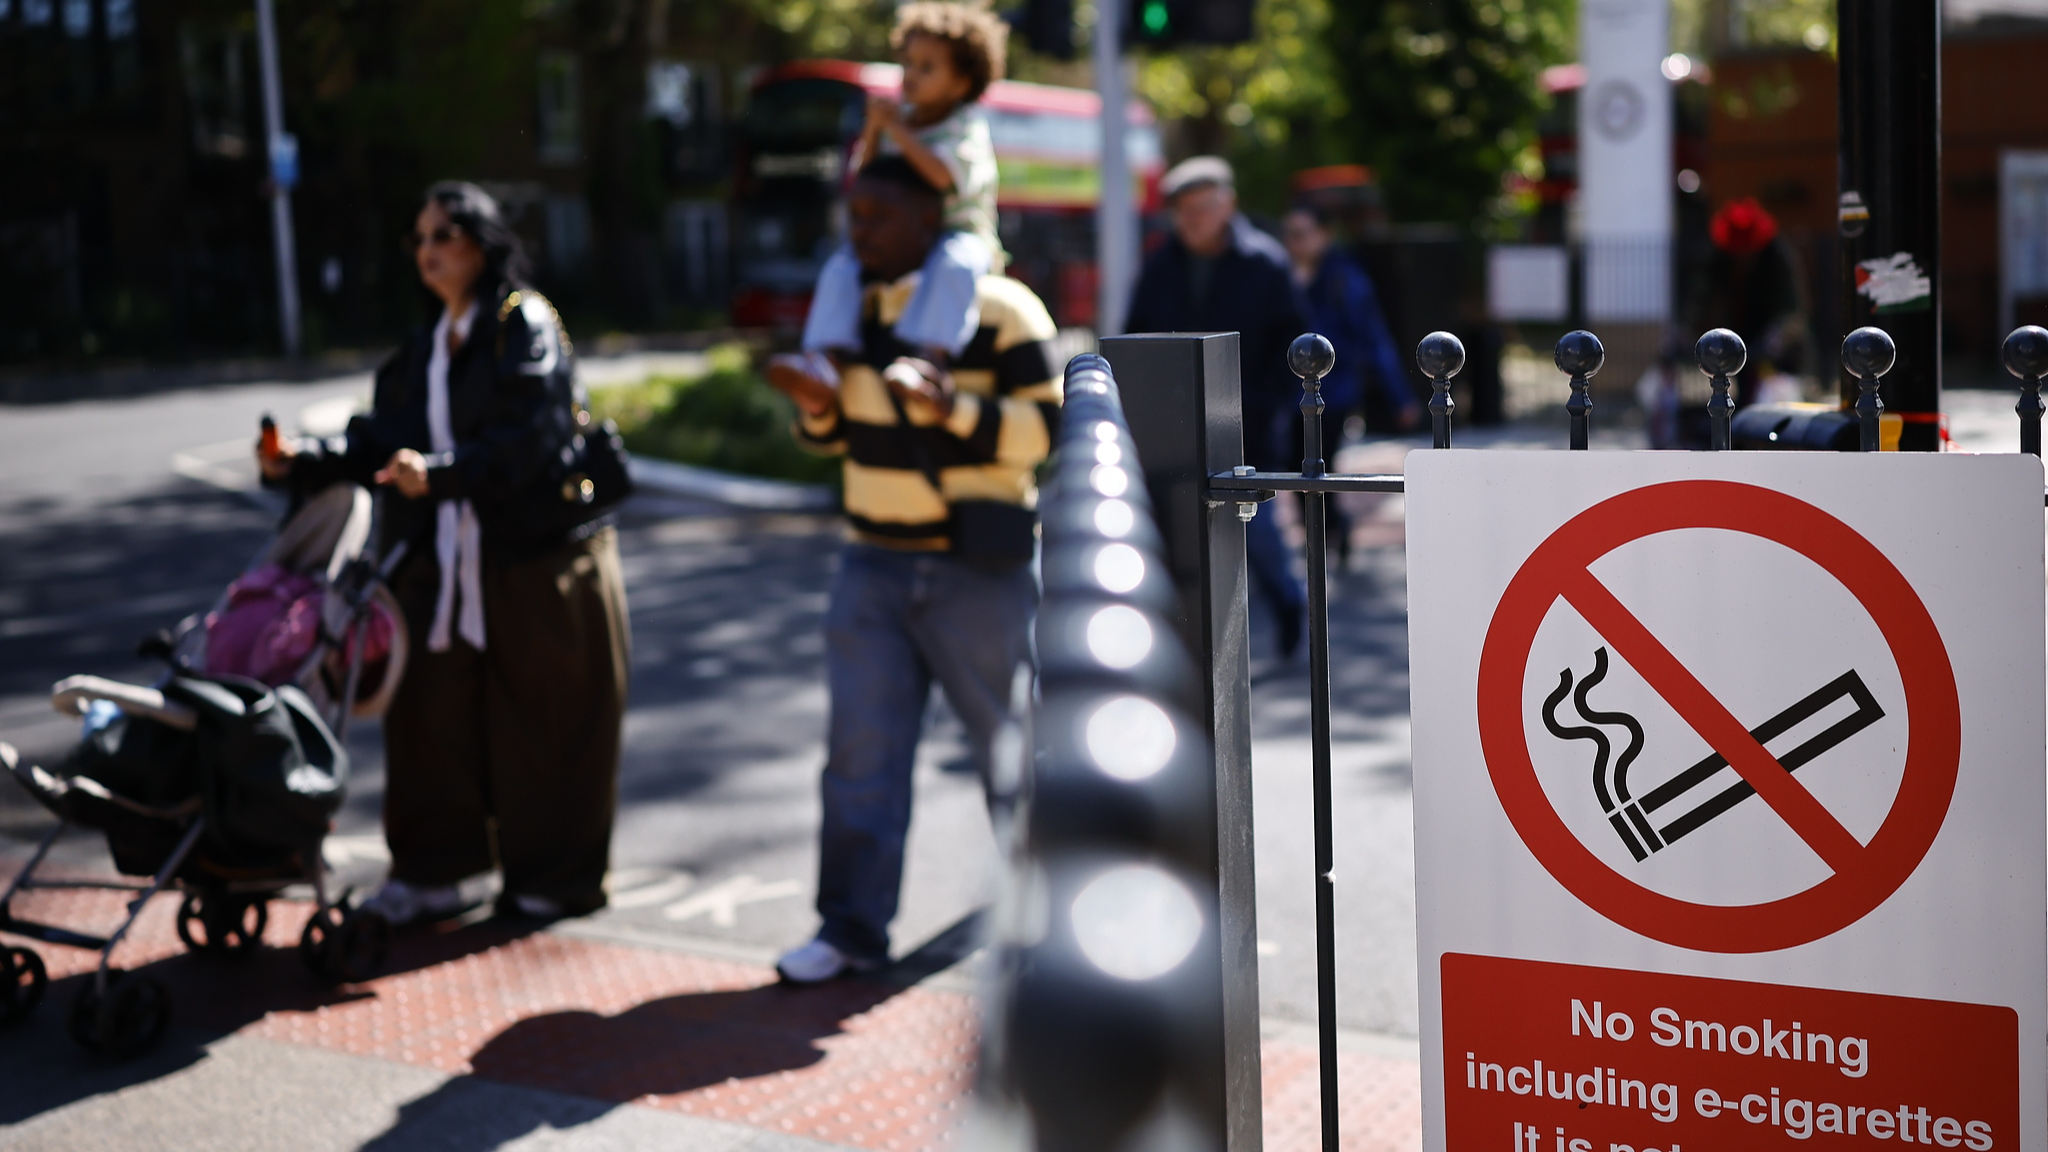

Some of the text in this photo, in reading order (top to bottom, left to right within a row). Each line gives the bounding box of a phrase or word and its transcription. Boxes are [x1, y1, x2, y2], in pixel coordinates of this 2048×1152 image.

[1570, 998, 1869, 1078] No Smoking
[1466, 1051, 1993, 1152] including e-cigarettes
[1513, 1121, 1541, 1152] It
